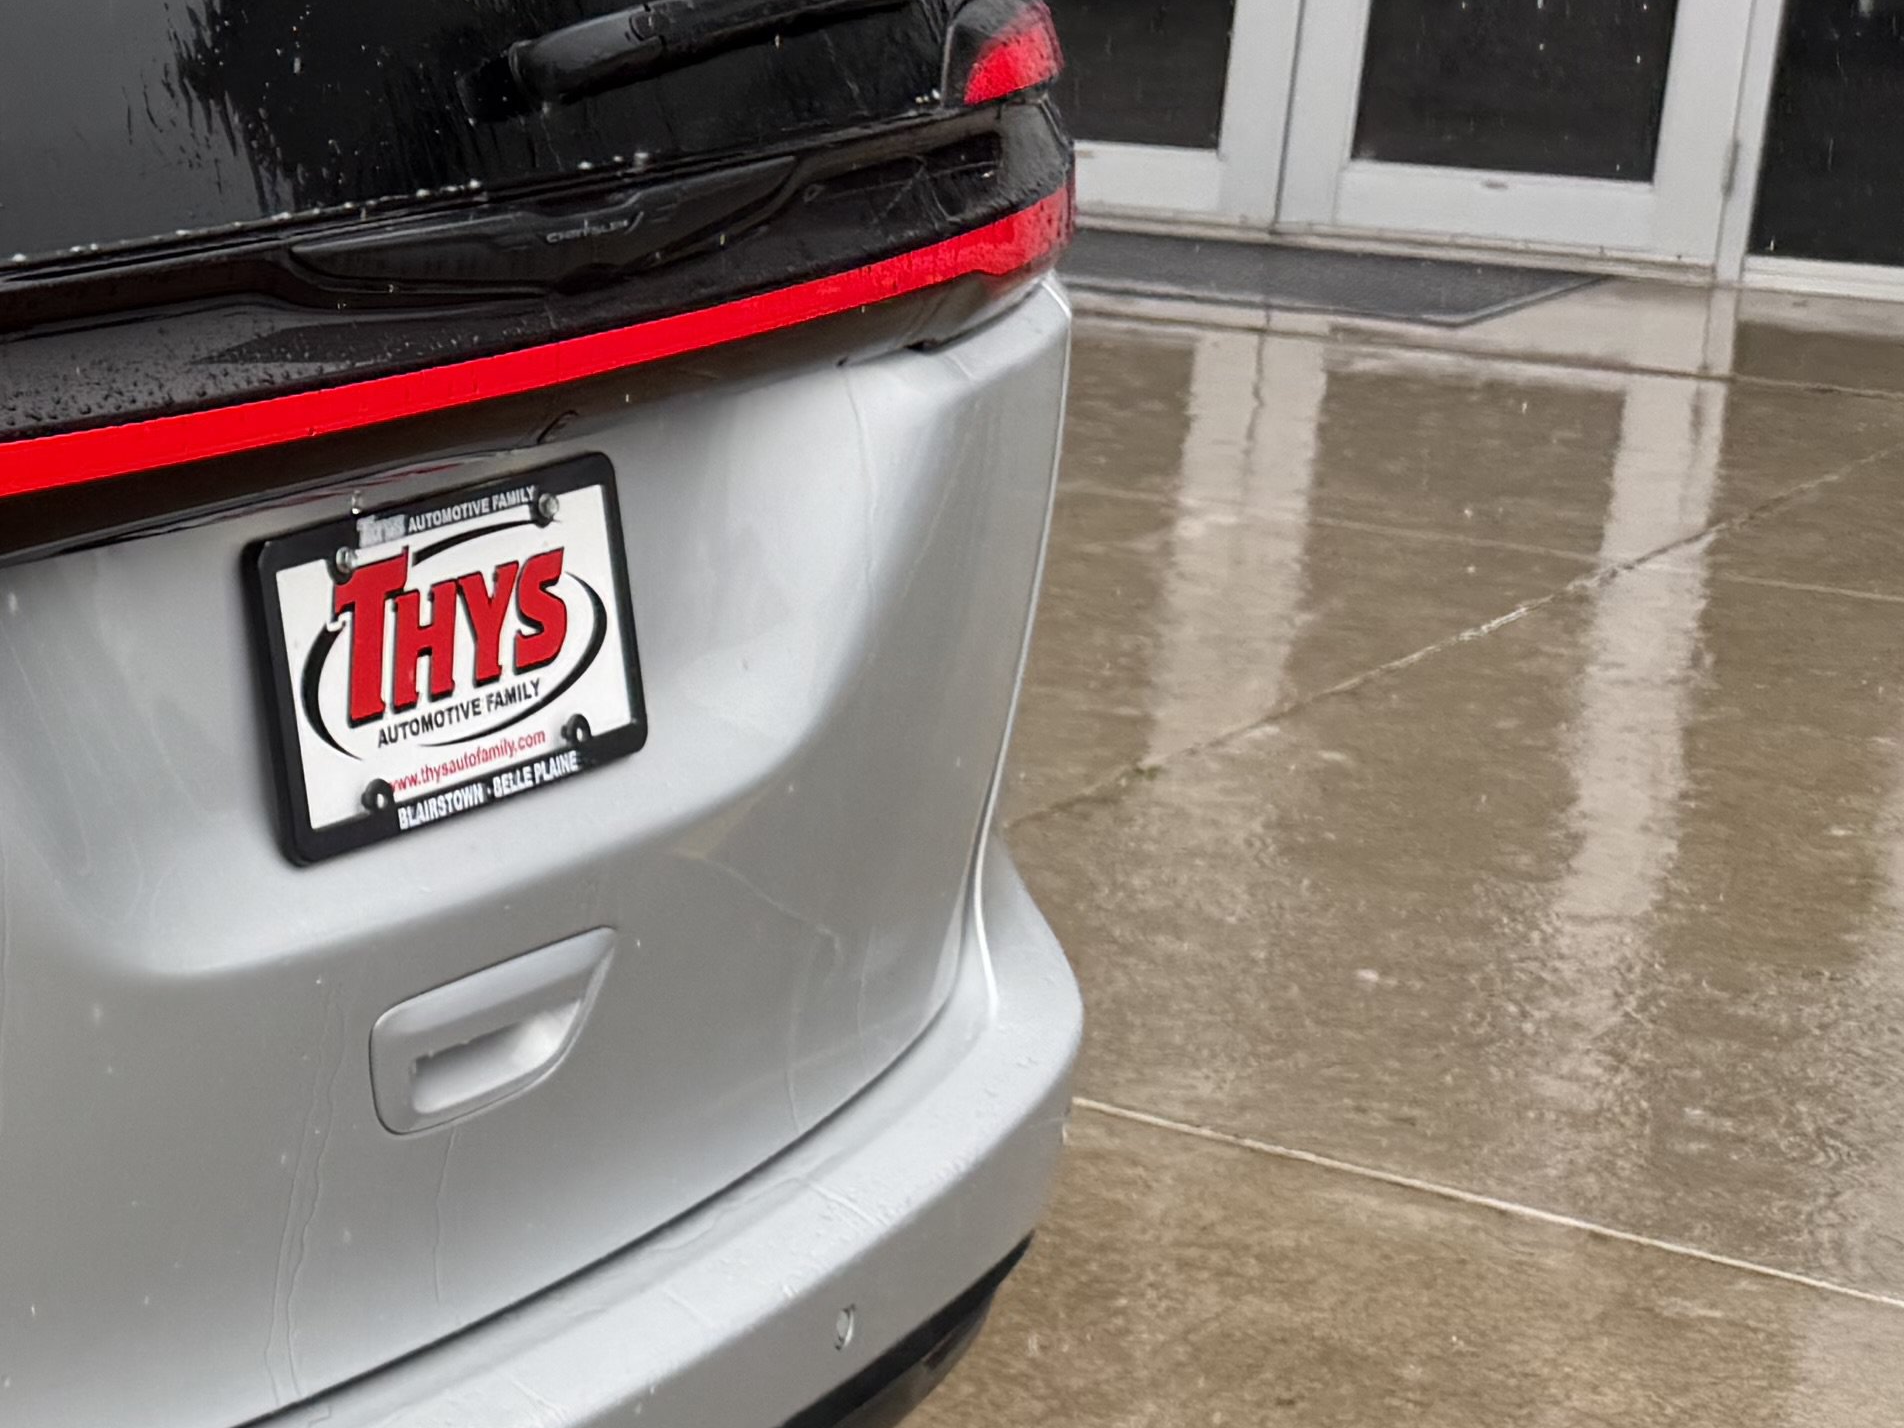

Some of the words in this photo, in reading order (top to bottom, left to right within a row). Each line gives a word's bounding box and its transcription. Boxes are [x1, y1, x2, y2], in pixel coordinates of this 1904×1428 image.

[408, 498, 490, 533] AUTOMOTIVE
[492, 486, 536, 512] FAMILY
[333, 546, 568, 728] THYS
[377, 697, 482, 748] AUTOMOTIVE
[486, 678, 541, 713] FAMILY
[398, 783, 484, 830] BLAIRSTOWN
[493, 766, 534, 798] BELLE
[534, 750, 579, 784] PLAINE
